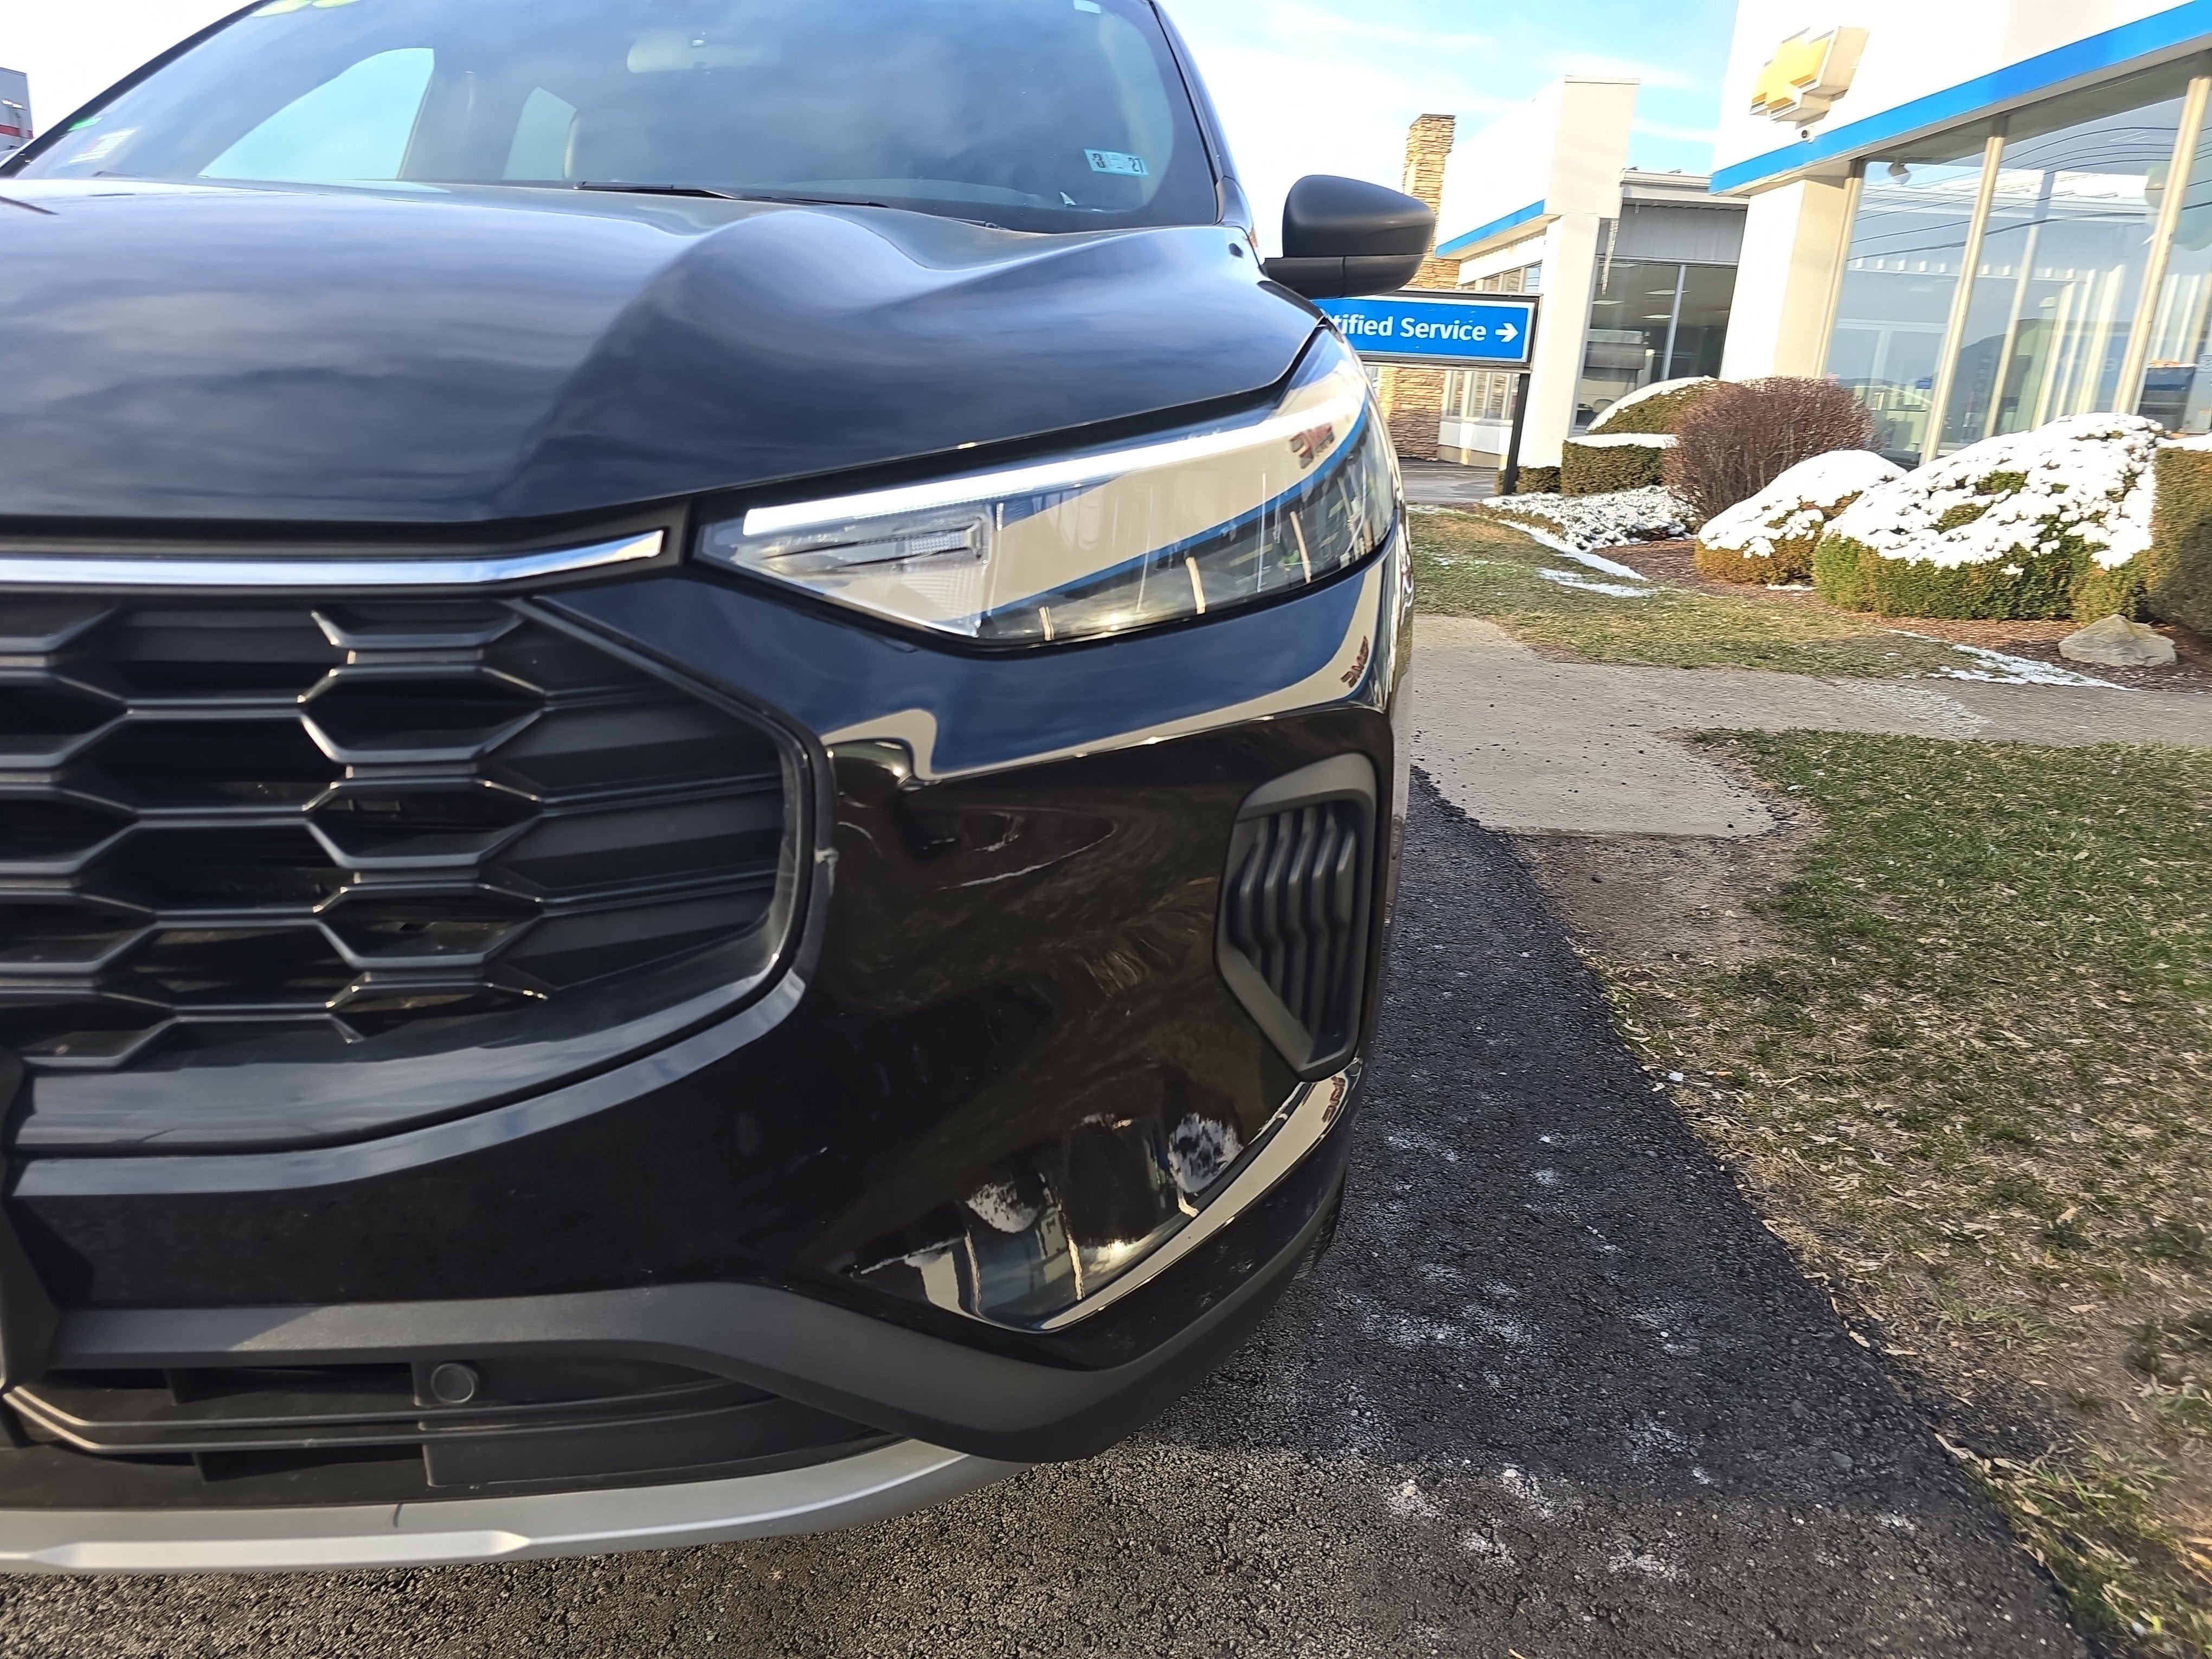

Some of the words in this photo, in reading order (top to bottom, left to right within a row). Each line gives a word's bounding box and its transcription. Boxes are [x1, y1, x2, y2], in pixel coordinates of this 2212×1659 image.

[1092, 153, 1106, 168] 3
[1128, 157, 1143, 173] 27
[1399, 317, 1487, 342] Service
